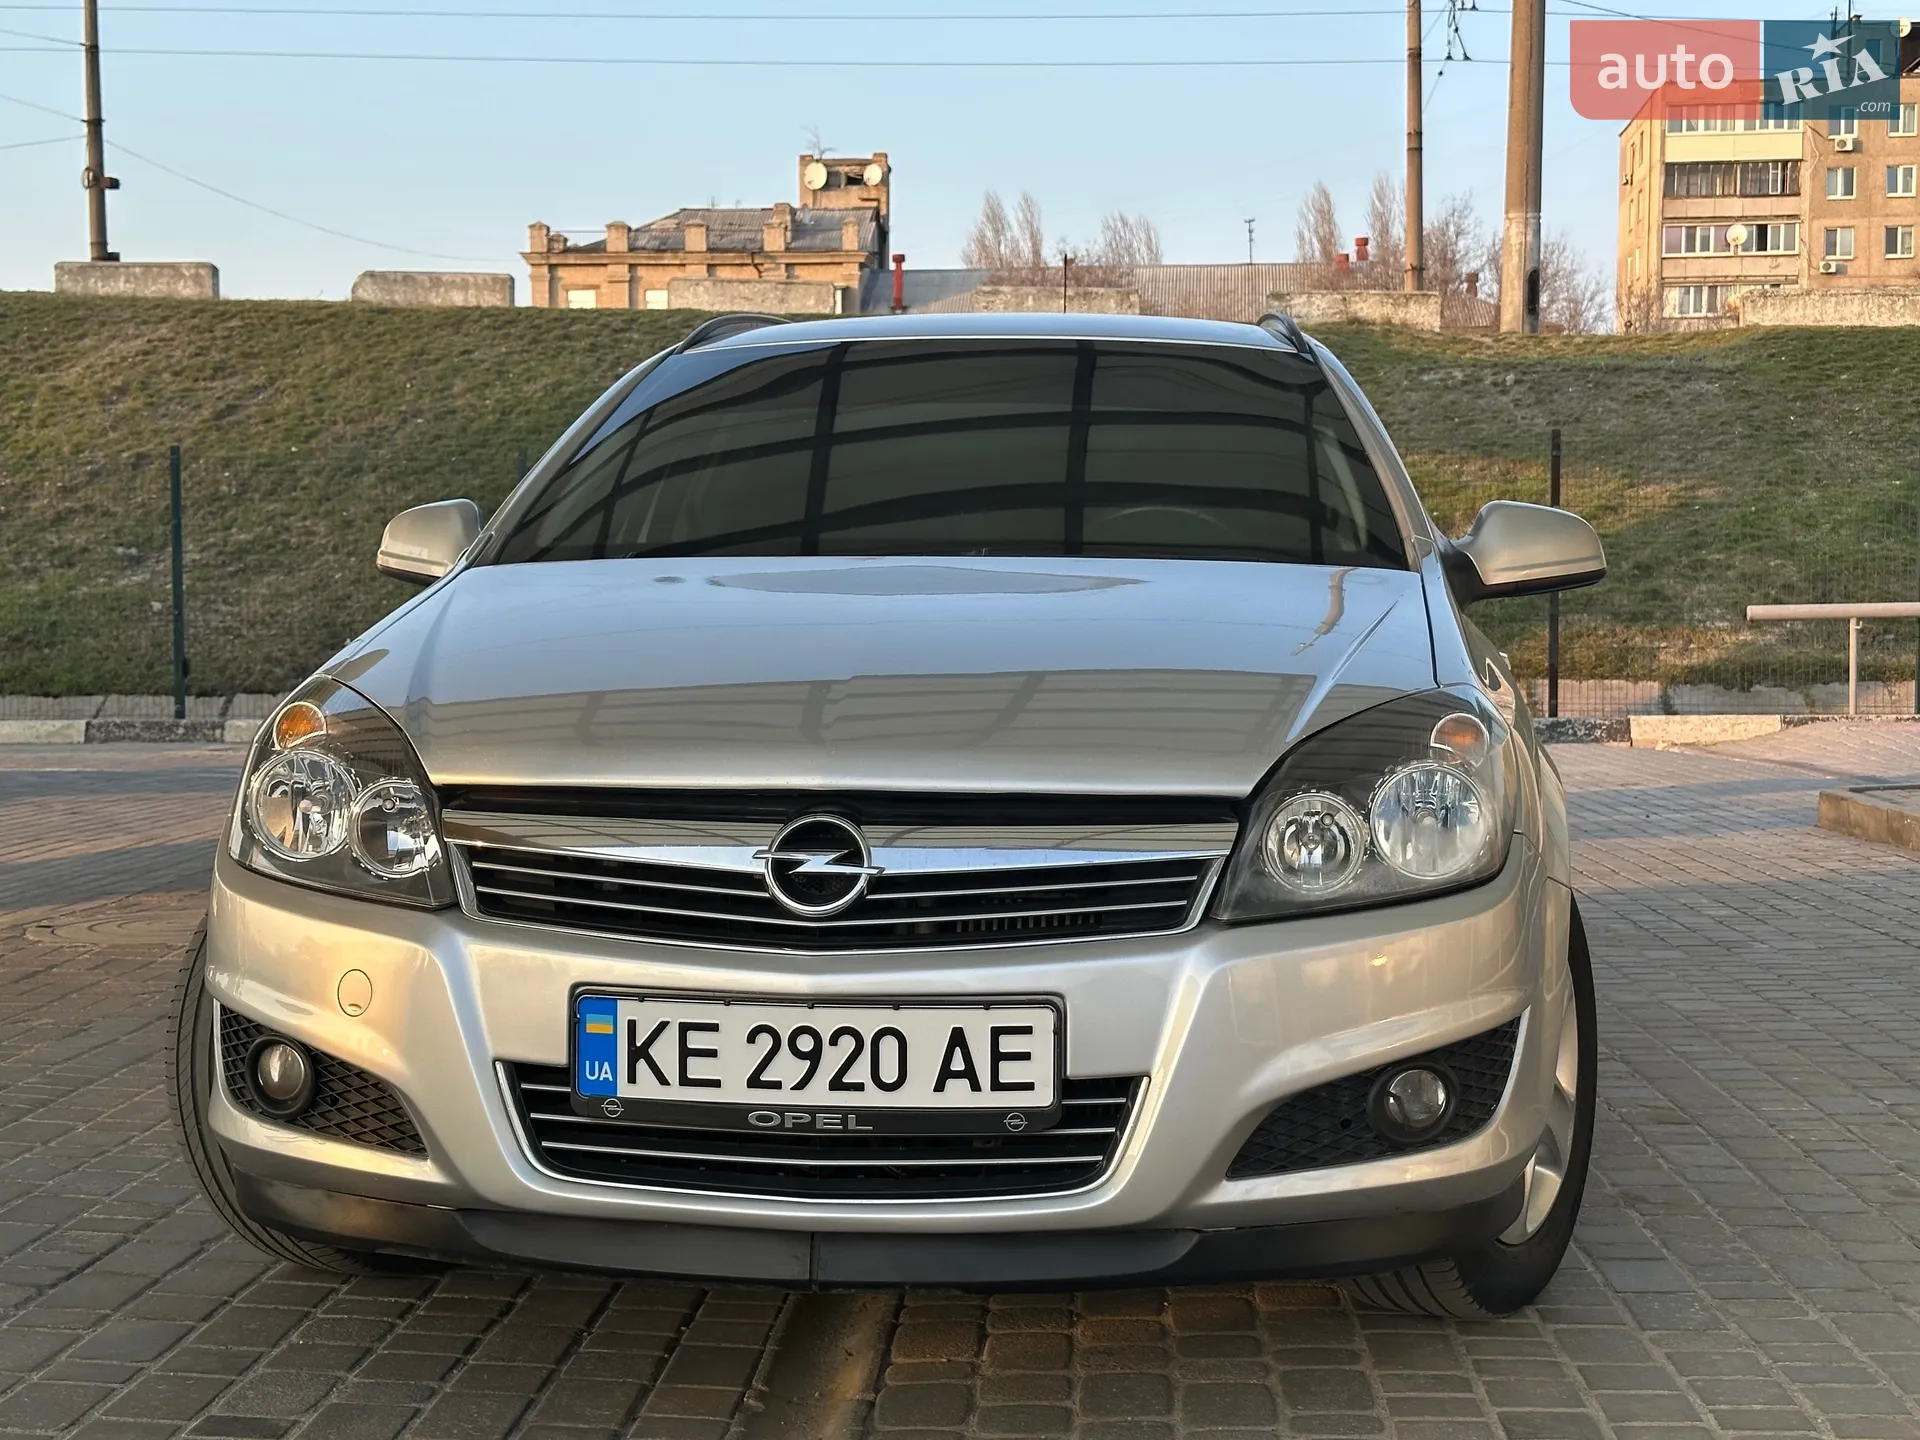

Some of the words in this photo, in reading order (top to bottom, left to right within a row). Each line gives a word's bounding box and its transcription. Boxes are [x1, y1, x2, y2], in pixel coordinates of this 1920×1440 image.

[626, 1019, 722, 1088] KE
[746, 1023, 908, 1093] 2920
[932, 1025, 1036, 1093] AE
[585, 1060, 613, 1081] UA
[747, 1110, 873, 1130] OPEL
